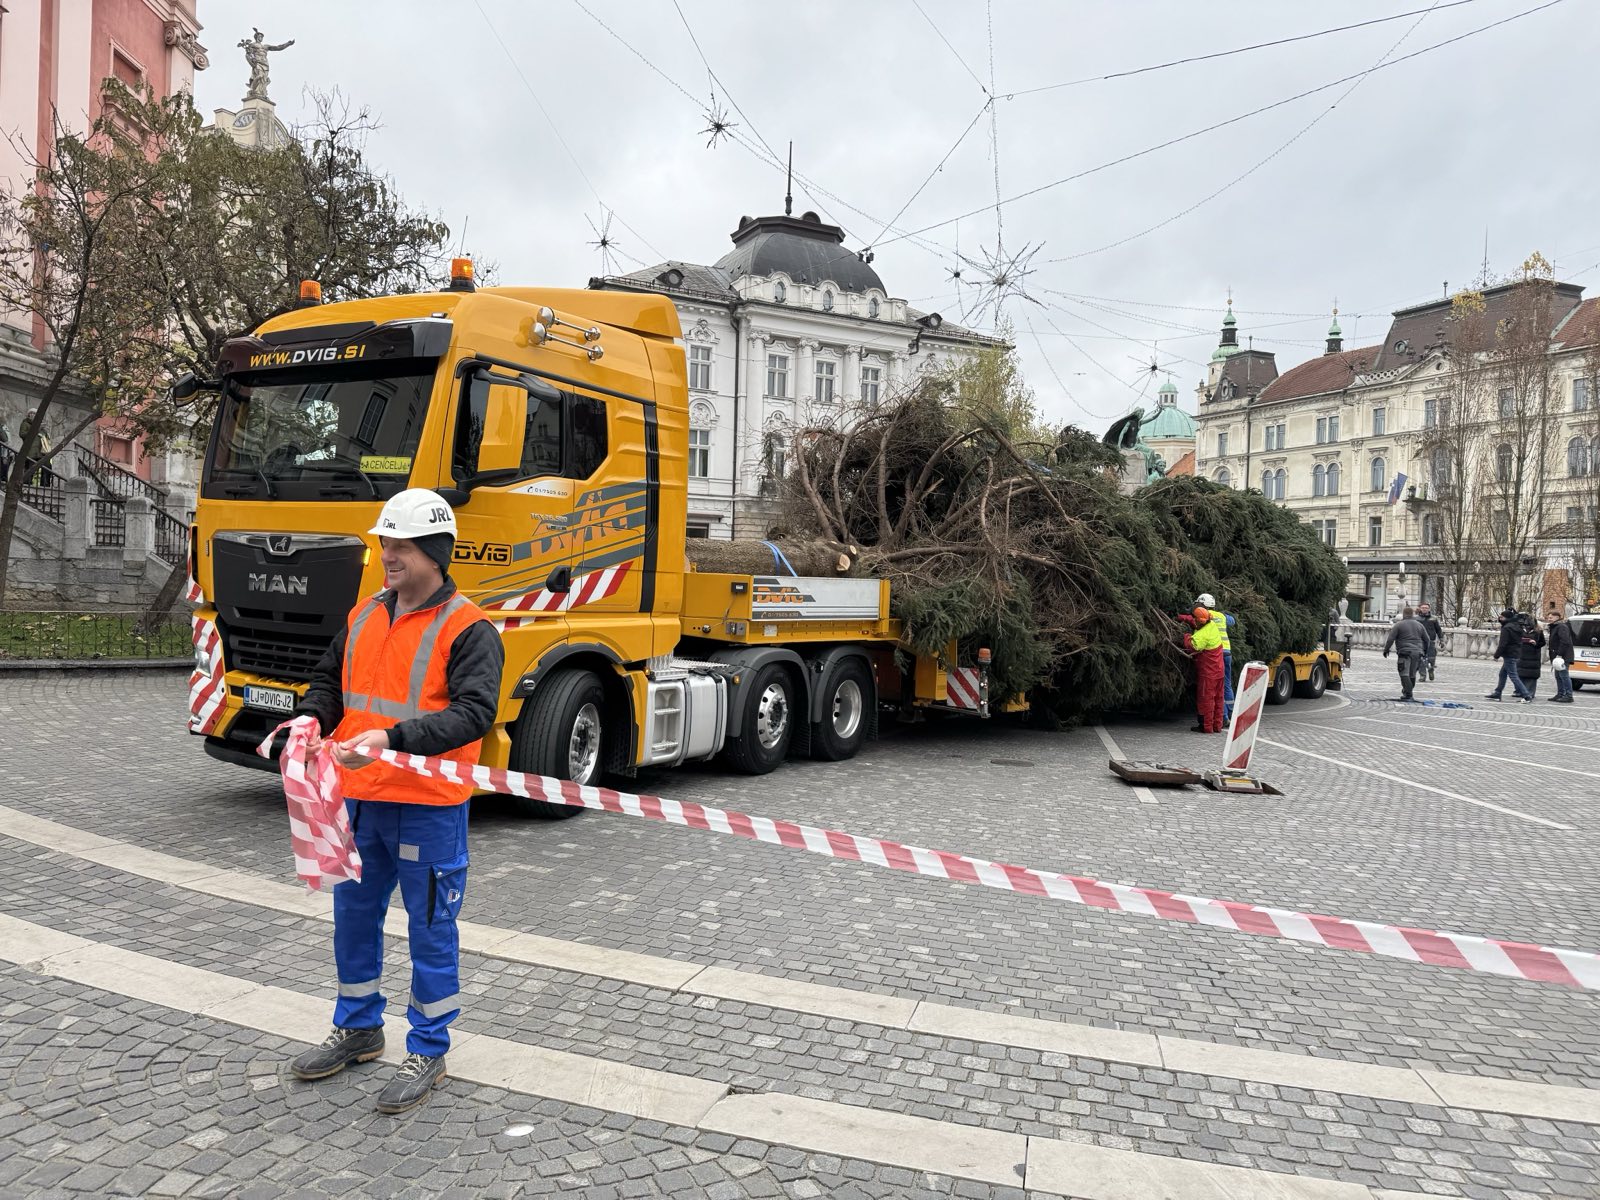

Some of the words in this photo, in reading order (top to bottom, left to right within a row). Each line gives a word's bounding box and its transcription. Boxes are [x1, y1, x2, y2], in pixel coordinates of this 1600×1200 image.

[250, 344, 366, 367] WWW.DVIG.SI
[429, 507, 452, 523] JRL
[385, 522, 396, 530] JRL
[248, 573, 308, 595] MAN
[250, 689, 260, 703] LJ
